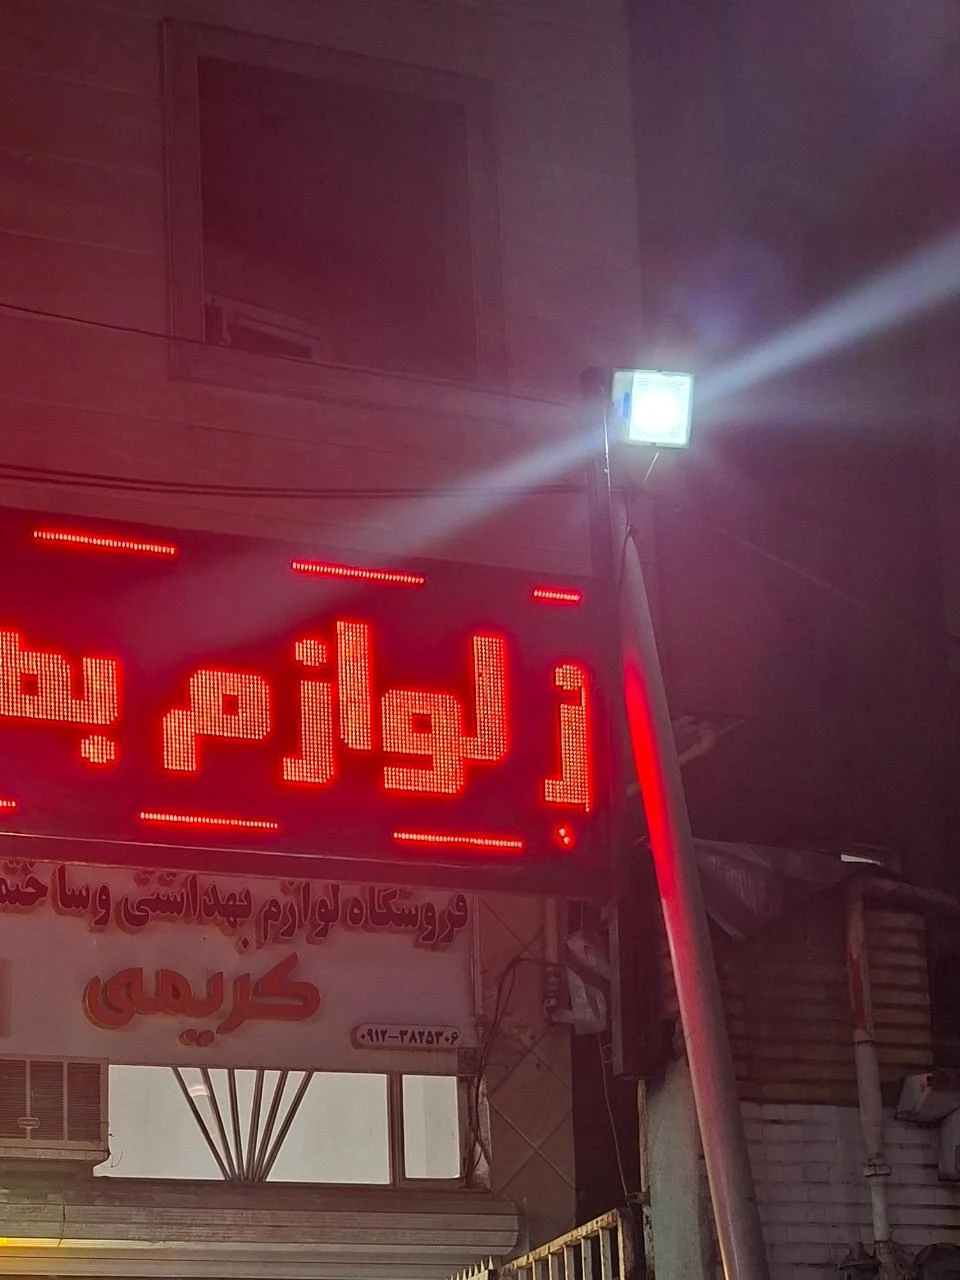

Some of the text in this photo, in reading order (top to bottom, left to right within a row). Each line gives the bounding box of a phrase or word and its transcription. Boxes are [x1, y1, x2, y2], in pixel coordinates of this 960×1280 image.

[162, 621, 508, 794] لوازم
[259, 879, 341, 945] لوازم
[83, 952, 321, 1047] کریمی
